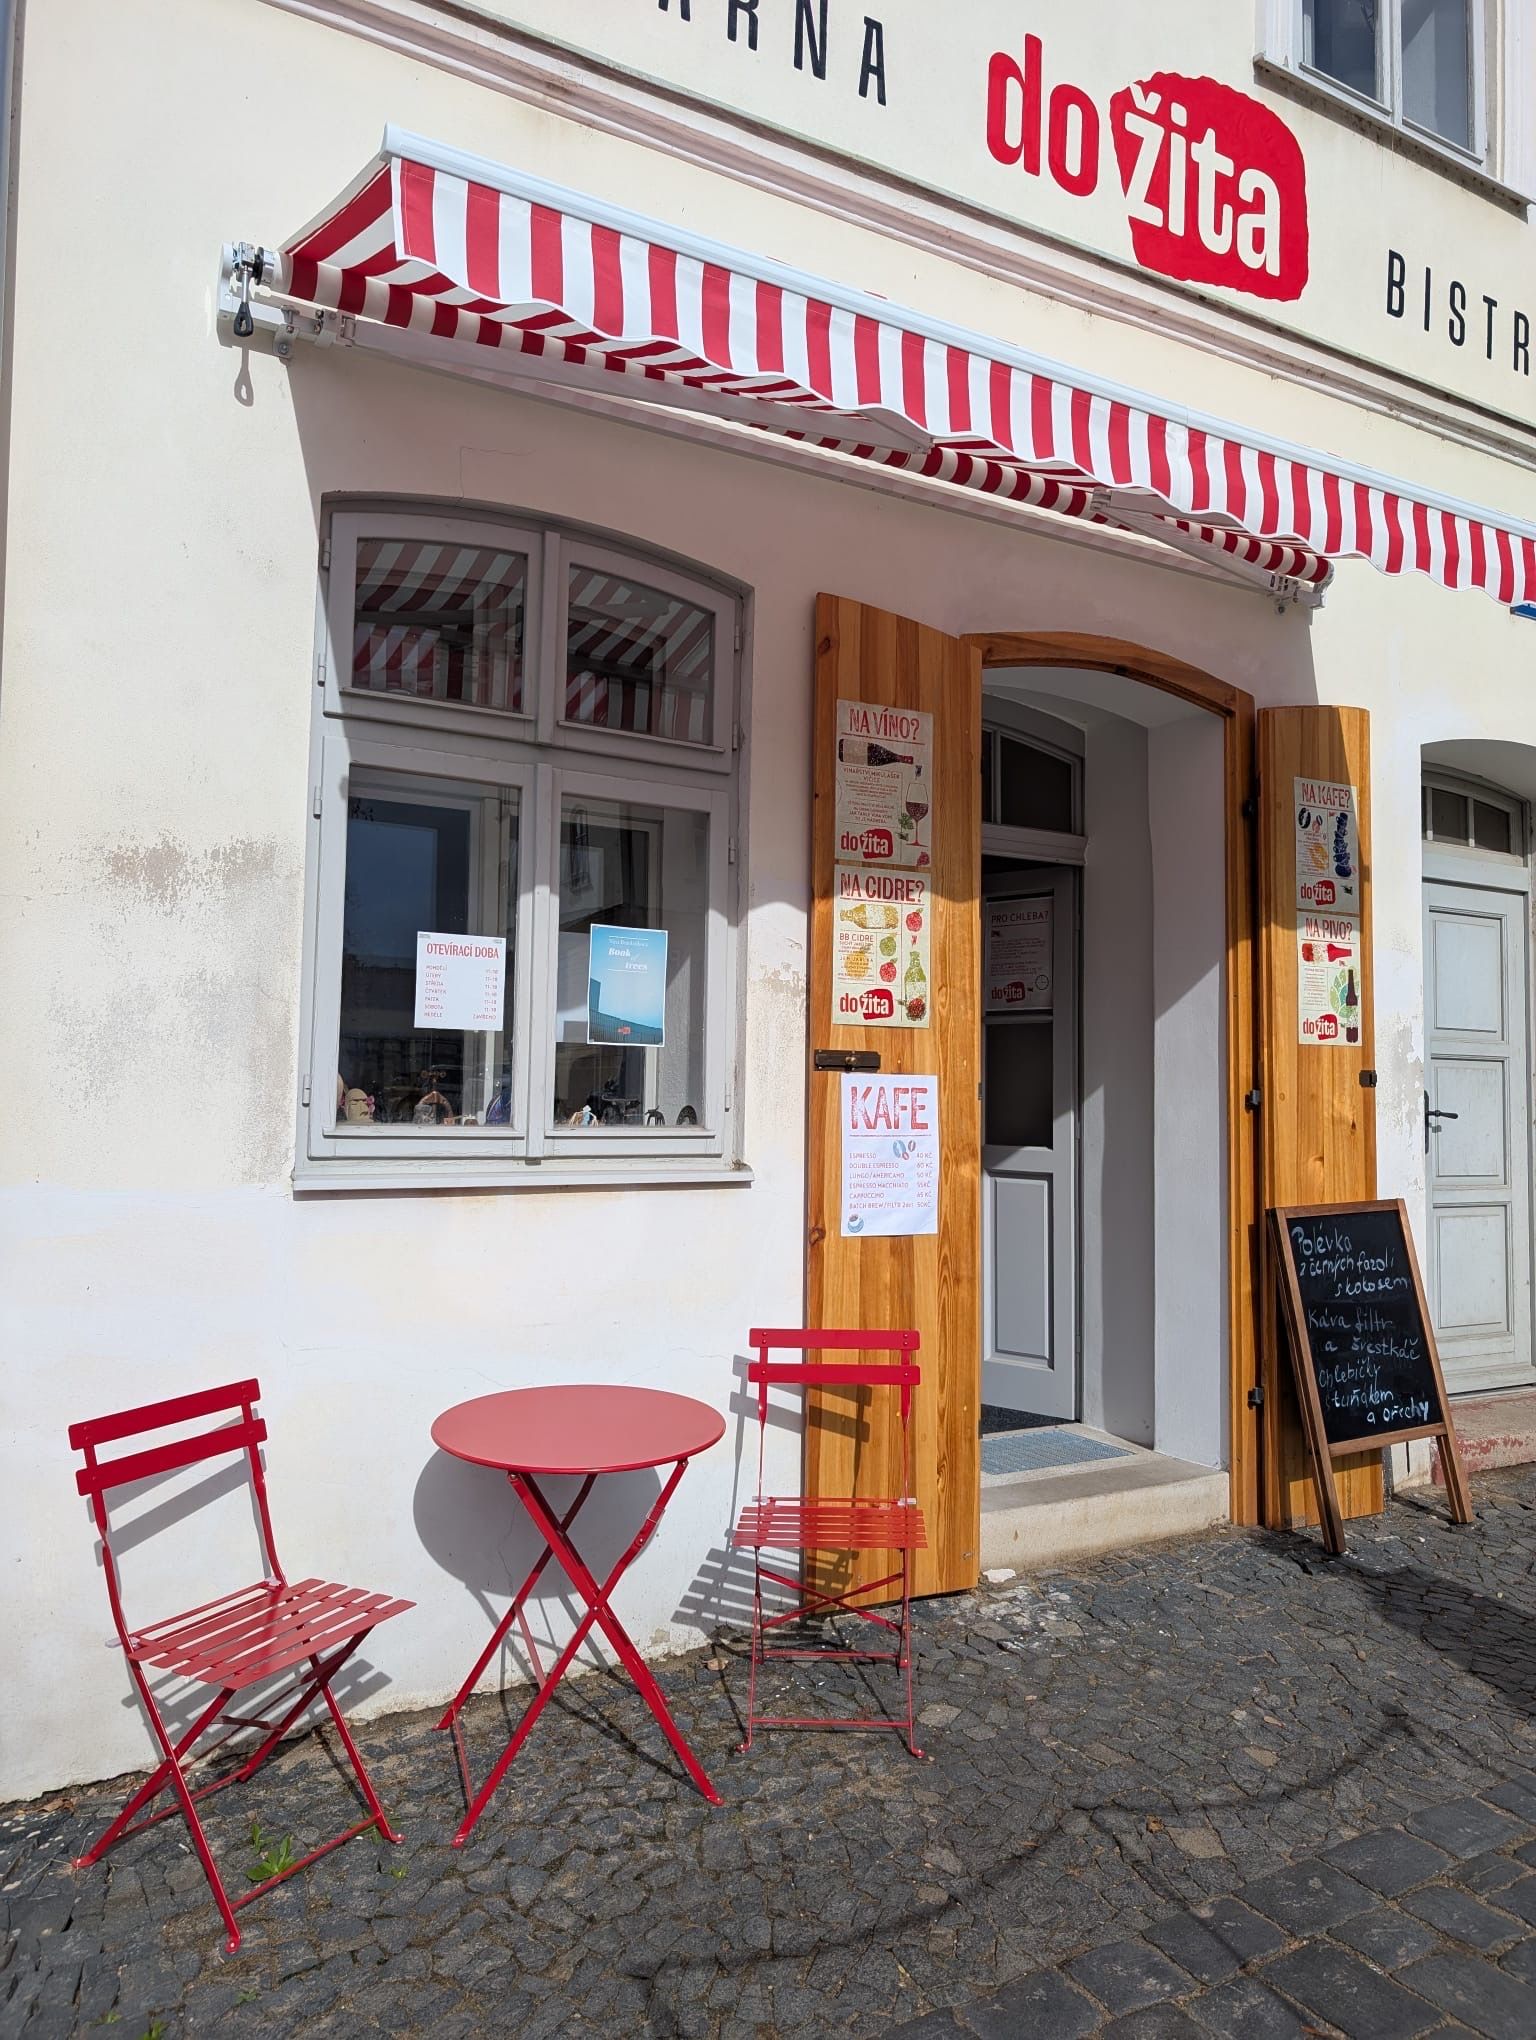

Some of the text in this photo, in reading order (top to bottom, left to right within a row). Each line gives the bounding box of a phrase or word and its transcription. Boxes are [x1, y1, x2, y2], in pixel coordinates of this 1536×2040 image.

[658, 0, 886, 106] RNA
[1387, 249, 1530, 376] BISTR
[850, 707, 920, 740] NA VÍNO?
[1302, 783, 1350, 808] NA KAFE?
[840, 873, 925, 902] NA CIDRE?
[992, 911, 1048, 924] PRO CHLEBA?
[1305, 917, 1352, 940] NA PIVO?
[852, 934, 874, 942] CIDRE
[427, 942, 499, 959] OTEVÍRACÍ DOBA
[850, 1086, 929, 1130] KAFE
[1291, 1222, 1353, 1256] Polévka
[1308, 1307, 1351, 1329] Káva
[1324, 1340, 1338, 1352] a
[1366, 1411, 1376, 1424] a
